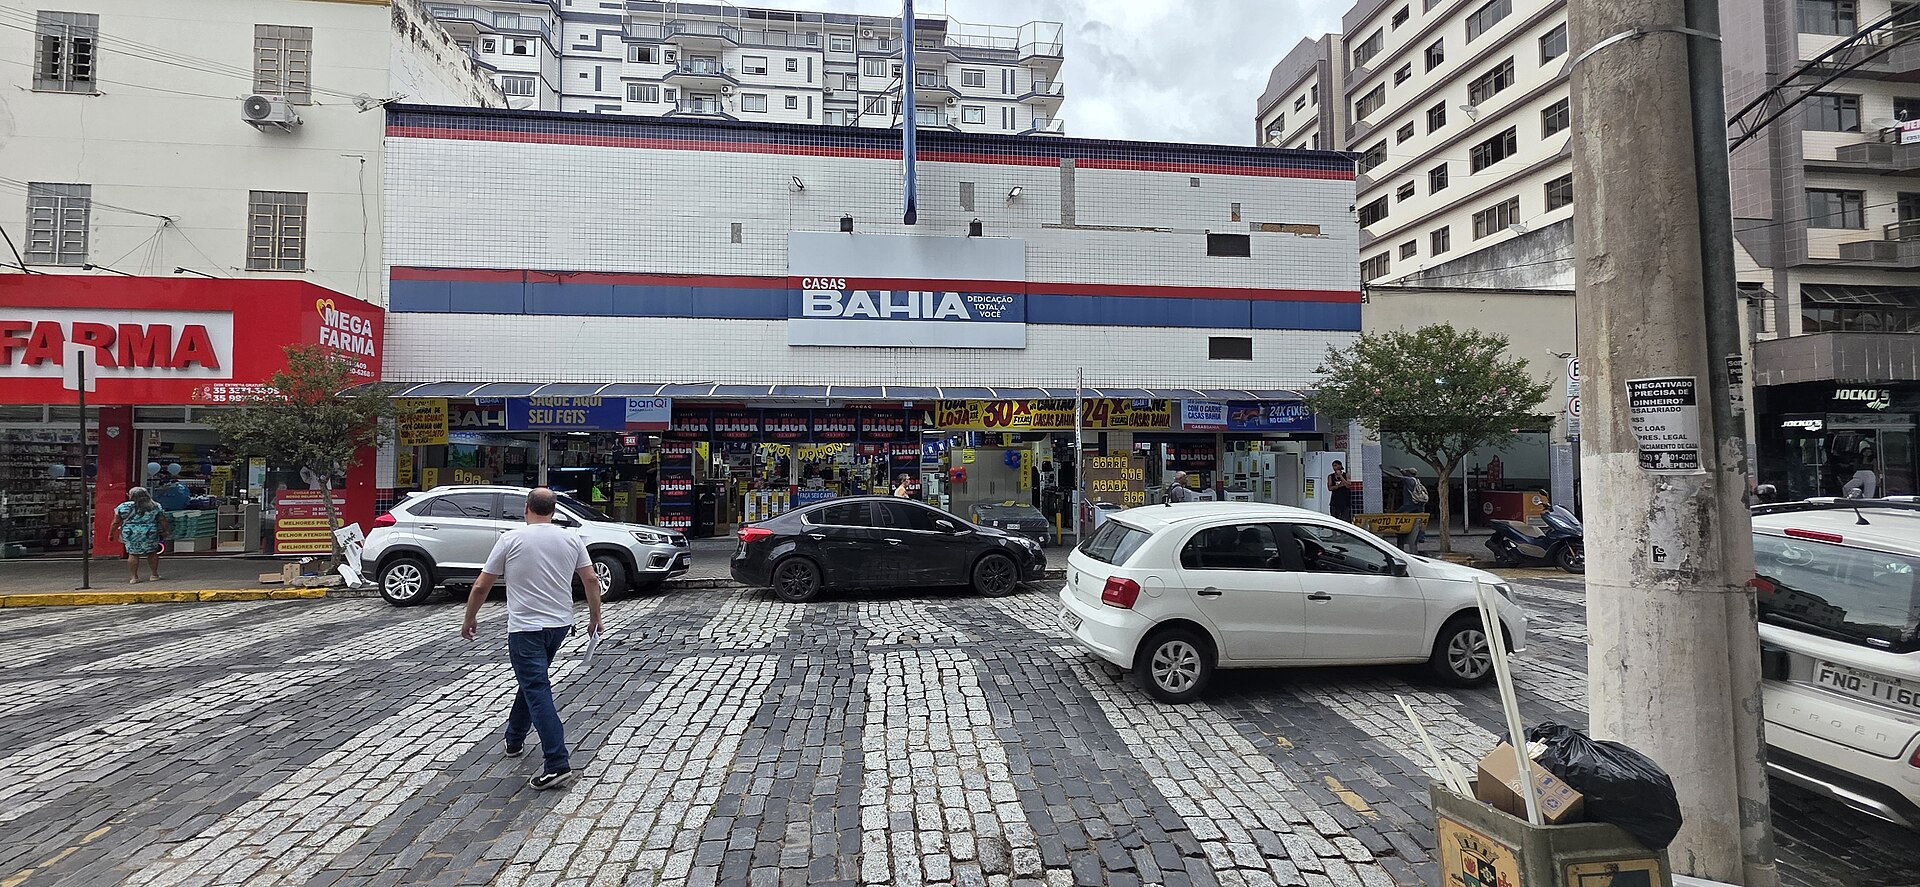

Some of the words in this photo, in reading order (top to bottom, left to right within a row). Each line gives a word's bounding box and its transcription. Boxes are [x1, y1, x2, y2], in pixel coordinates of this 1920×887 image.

[802, 278, 846, 290] CASAS
[802, 290, 971, 320] BAHIA
[967, 295, 1013, 304] DEDICAÇÃO
[974, 303, 998, 311] TOTAL
[979, 309, 1001, 318] VOCÊ
[325, 307, 373, 337] MEGA
[0, 320, 220, 371] FARMA
[320, 326, 375, 357] FARMA
[1635, 381, 1692, 390] NEGATIVADO
[1635, 389, 1676, 397] PRECISA
[1832, 389, 1890, 400] JOCKO'S
[529, 397, 569, 407] SAQUE
[573, 397, 602, 407] AQUI
[629, 397, 668, 408] banQi
[1633, 398, 1684, 406] DINHEIRO?
[448, 410, 505, 426] BAH
[528, 410, 552, 424] SEU
[556, 410, 586, 424] FGTS
[938, 409, 970, 427] LOJA
[1033, 413, 1054, 426] CASAS
[1187, 412, 1204, 420] CASAS
[1269, 406, 1286, 417] 24X
[714, 418, 759, 431] BLACK
[765, 418, 808, 431] BLACK
[814, 418, 856, 432] BLACK
[862, 418, 904, 432] BLACK
[1129, 412, 1150, 427] CASAS
[1151, 413, 1170, 427] BAHIA
[1819, 668, 1920, 708] FNQ-1160
[1776, 703, 1887, 741] ITROËN
